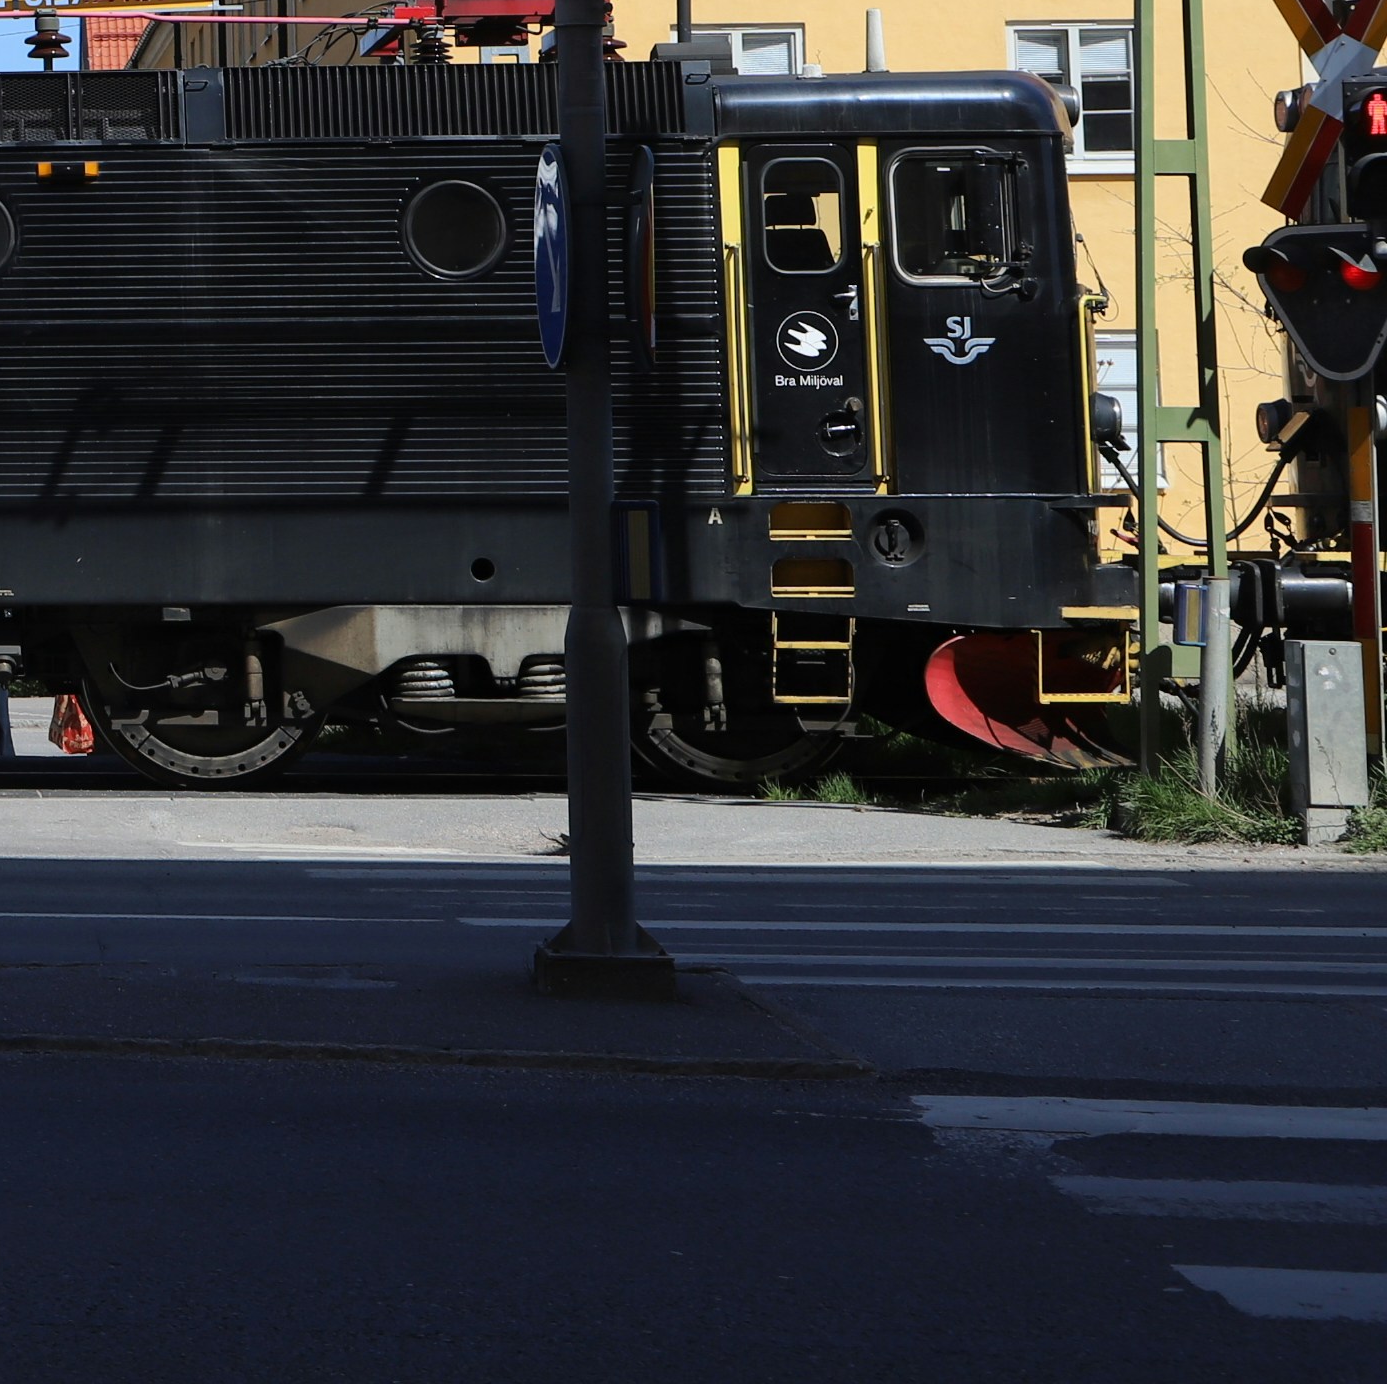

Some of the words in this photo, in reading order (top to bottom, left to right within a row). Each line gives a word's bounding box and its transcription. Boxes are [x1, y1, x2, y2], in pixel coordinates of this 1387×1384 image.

[946, 316, 972, 338] SJ
[775, 375, 797, 387] Bra
[799, 374, 844, 390] Miljöval
[708, 507, 723, 525] A
